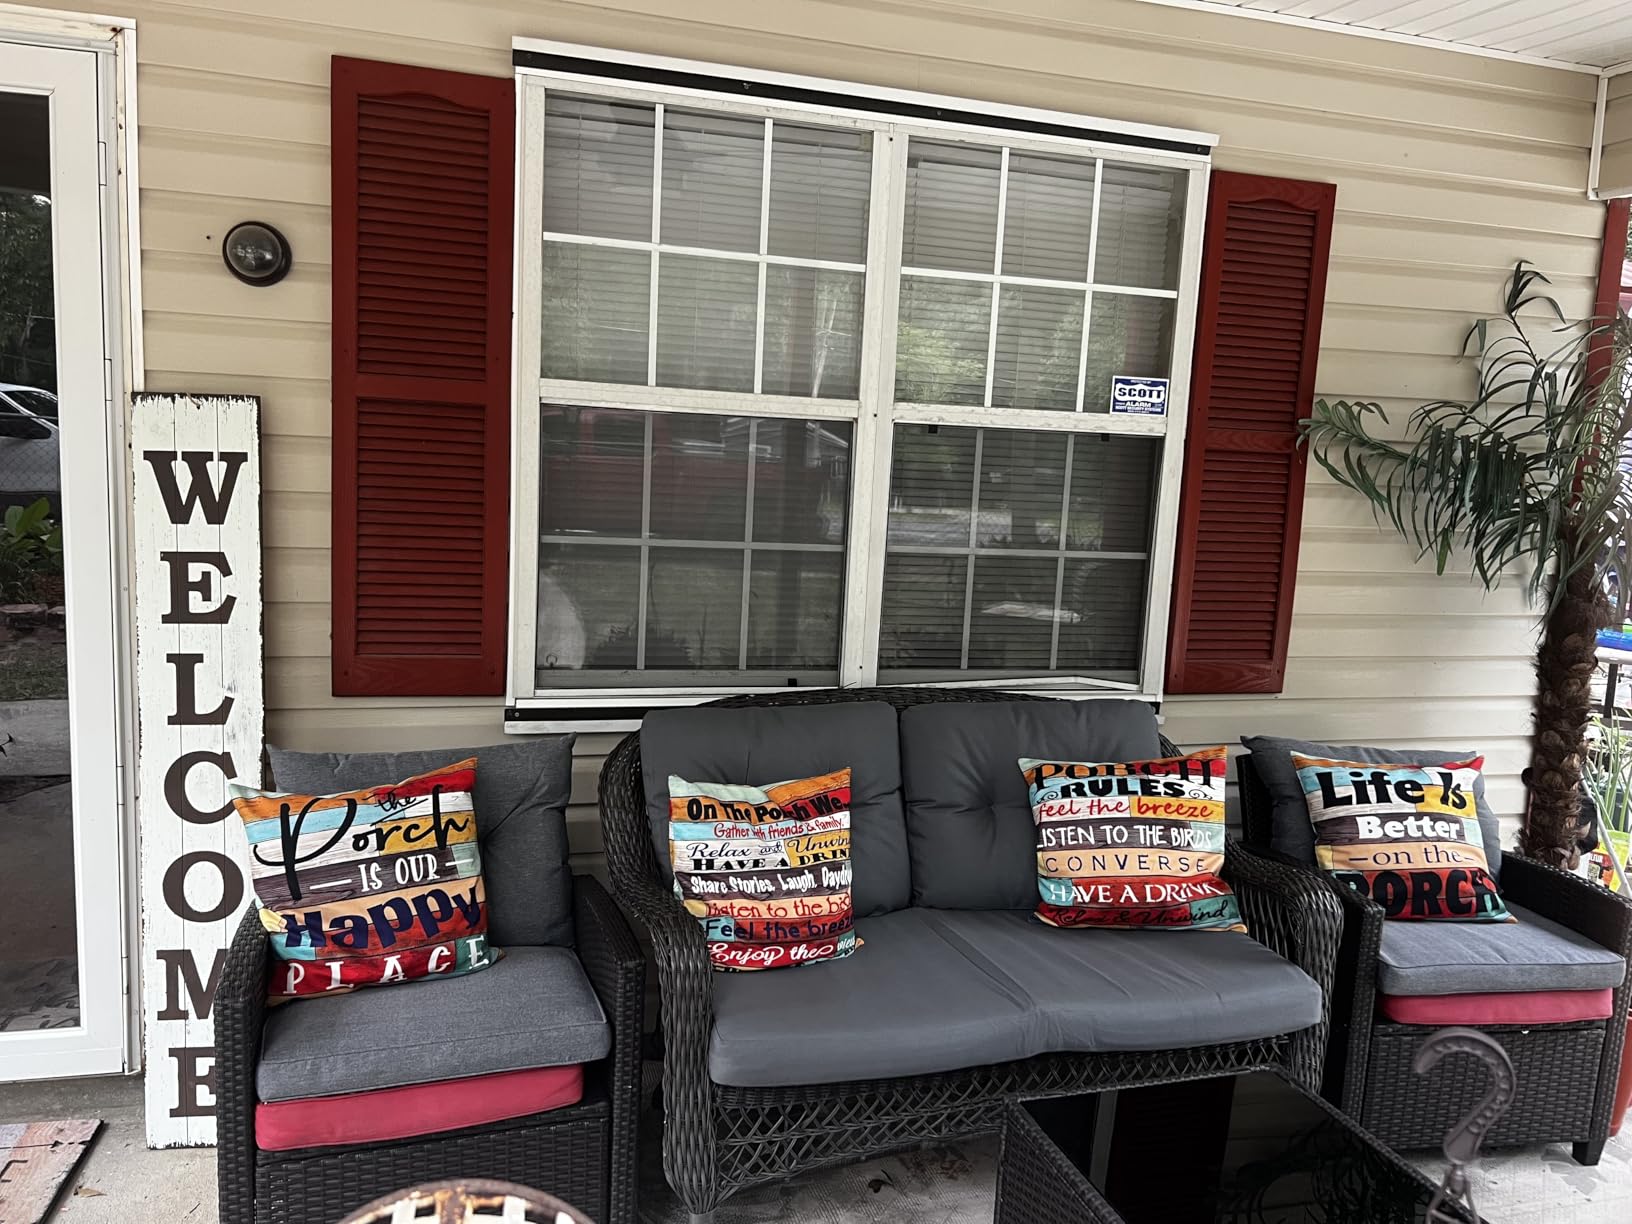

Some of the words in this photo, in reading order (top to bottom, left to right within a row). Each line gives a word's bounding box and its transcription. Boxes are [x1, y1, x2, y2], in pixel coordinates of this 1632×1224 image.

[1118, 387, 1163, 399] SCOTT
[143, 450, 248, 1117] WELCOME
[1060, 778, 1185, 798] RULES
[1316, 771, 1425, 809] Life
[1437, 771, 1467, 809] Is
[374, 790, 416, 812] the
[687, 798, 717, 821] On
[754, 800, 811, 822] Poh
[1039, 799, 1081, 819] feel
[1087, 798, 1129, 816] the
[1137, 796, 1213, 818] breeze
[714, 823, 750, 839] Gather
[768, 819, 803, 839] friends
[806, 822, 816, 832] &
[1101, 825, 1129, 844] TO
[1133, 825, 1167, 846] THE
[1171, 828, 1212, 849] BIRDS
[1356, 816, 1460, 839] Better
[253, 784, 469, 901] Porch
[686, 842, 751, 858] Relax
[787, 835, 850, 853] Unwin
[691, 857, 766, 871] HAVE
[775, 857, 791, 871] A
[797, 848, 850, 866] DRIN
[1045, 854, 1208, 873] CONVERSE
[1372, 850, 1414, 866] on
[1424, 845, 1461, 864] the
[358, 863, 382, 892] IS
[394, 853, 440, 885] OUR
[691, 876, 728, 893] Share
[822, 865, 852, 889] Daydr
[1050, 883, 1113, 903] HAVE
[1119, 884, 1139, 903] A
[1146, 881, 1225, 903] DRINK
[280, 883, 482, 949] Happy
[766, 903, 788, 918] to
[793, 898, 823, 917] the
[705, 919, 754, 938] Feel
[763, 921, 800, 940] the
[283, 935, 489, 994] PLACE
[708, 943, 784, 965] Enjoy
[789, 943, 834, 960] the
